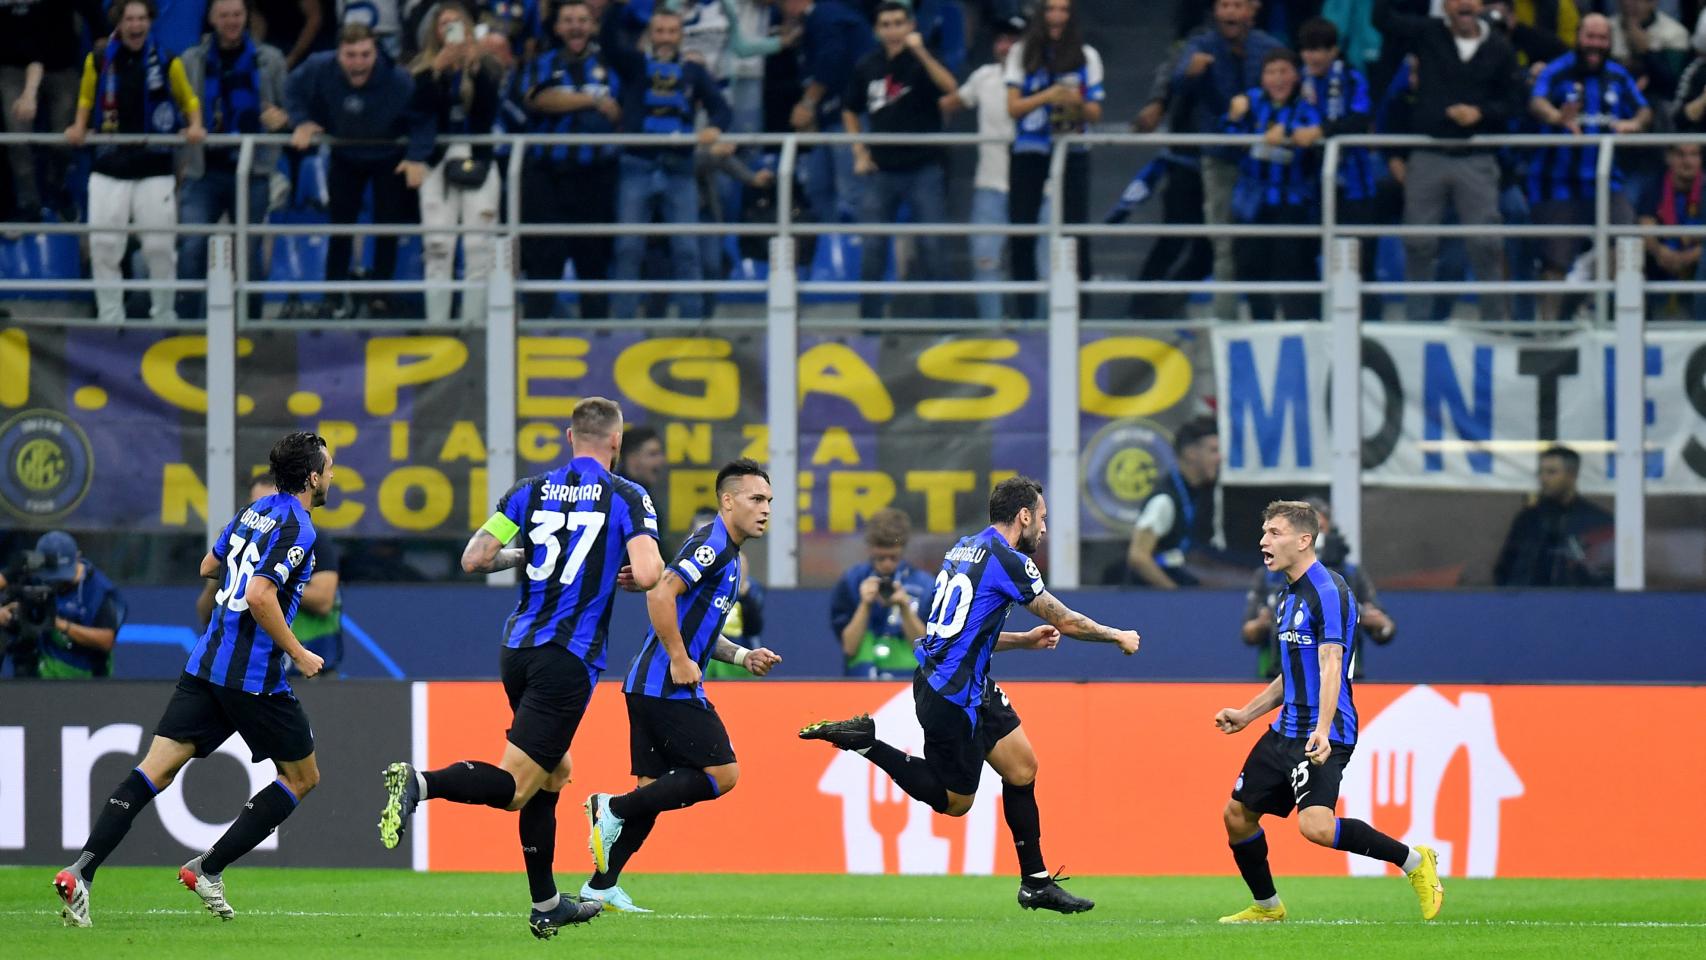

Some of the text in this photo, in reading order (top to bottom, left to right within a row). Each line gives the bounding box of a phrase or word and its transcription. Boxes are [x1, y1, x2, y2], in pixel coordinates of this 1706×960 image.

[317, 420, 861, 465] PIACNZA
[215, 533, 260, 612] 36
[526, 510, 606, 585] 37
[927, 569, 973, 639] 20
